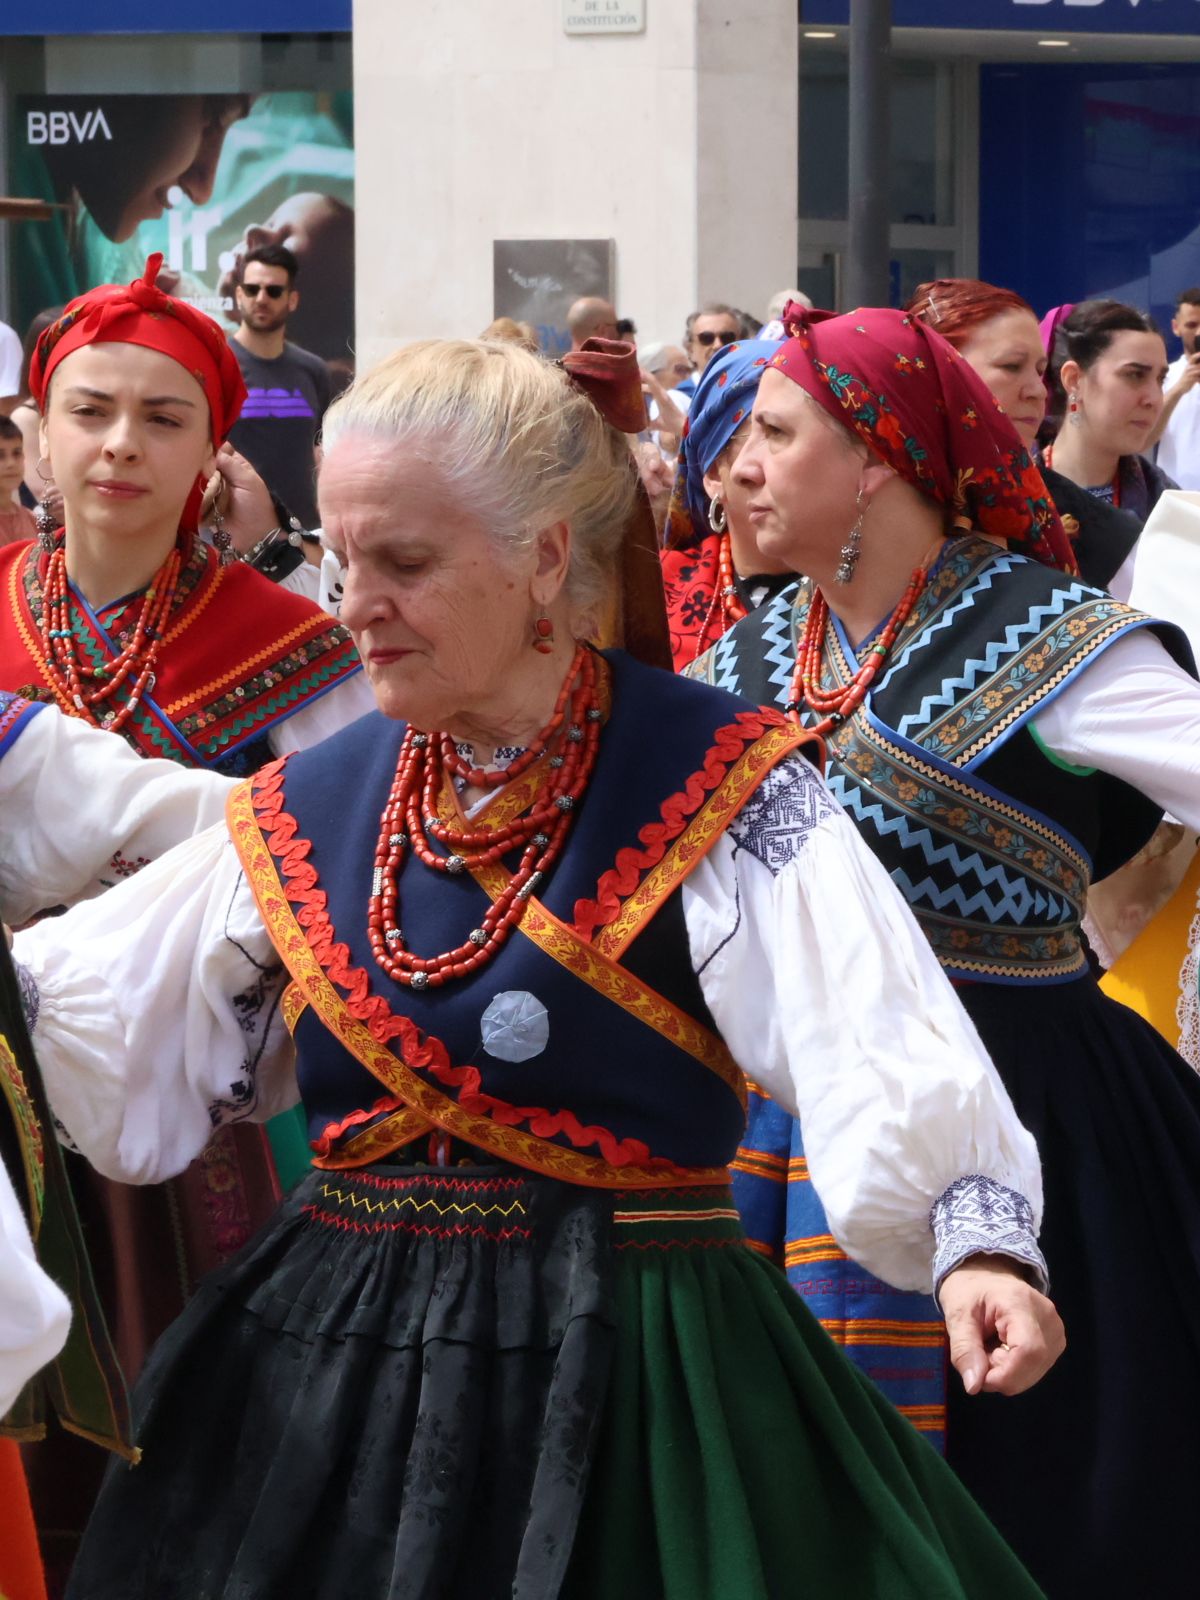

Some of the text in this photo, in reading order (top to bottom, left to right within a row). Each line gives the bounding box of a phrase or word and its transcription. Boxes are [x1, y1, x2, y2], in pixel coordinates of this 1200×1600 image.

[585, 0, 620, 11] DE LA
[27, 109, 112, 144] BBVA
